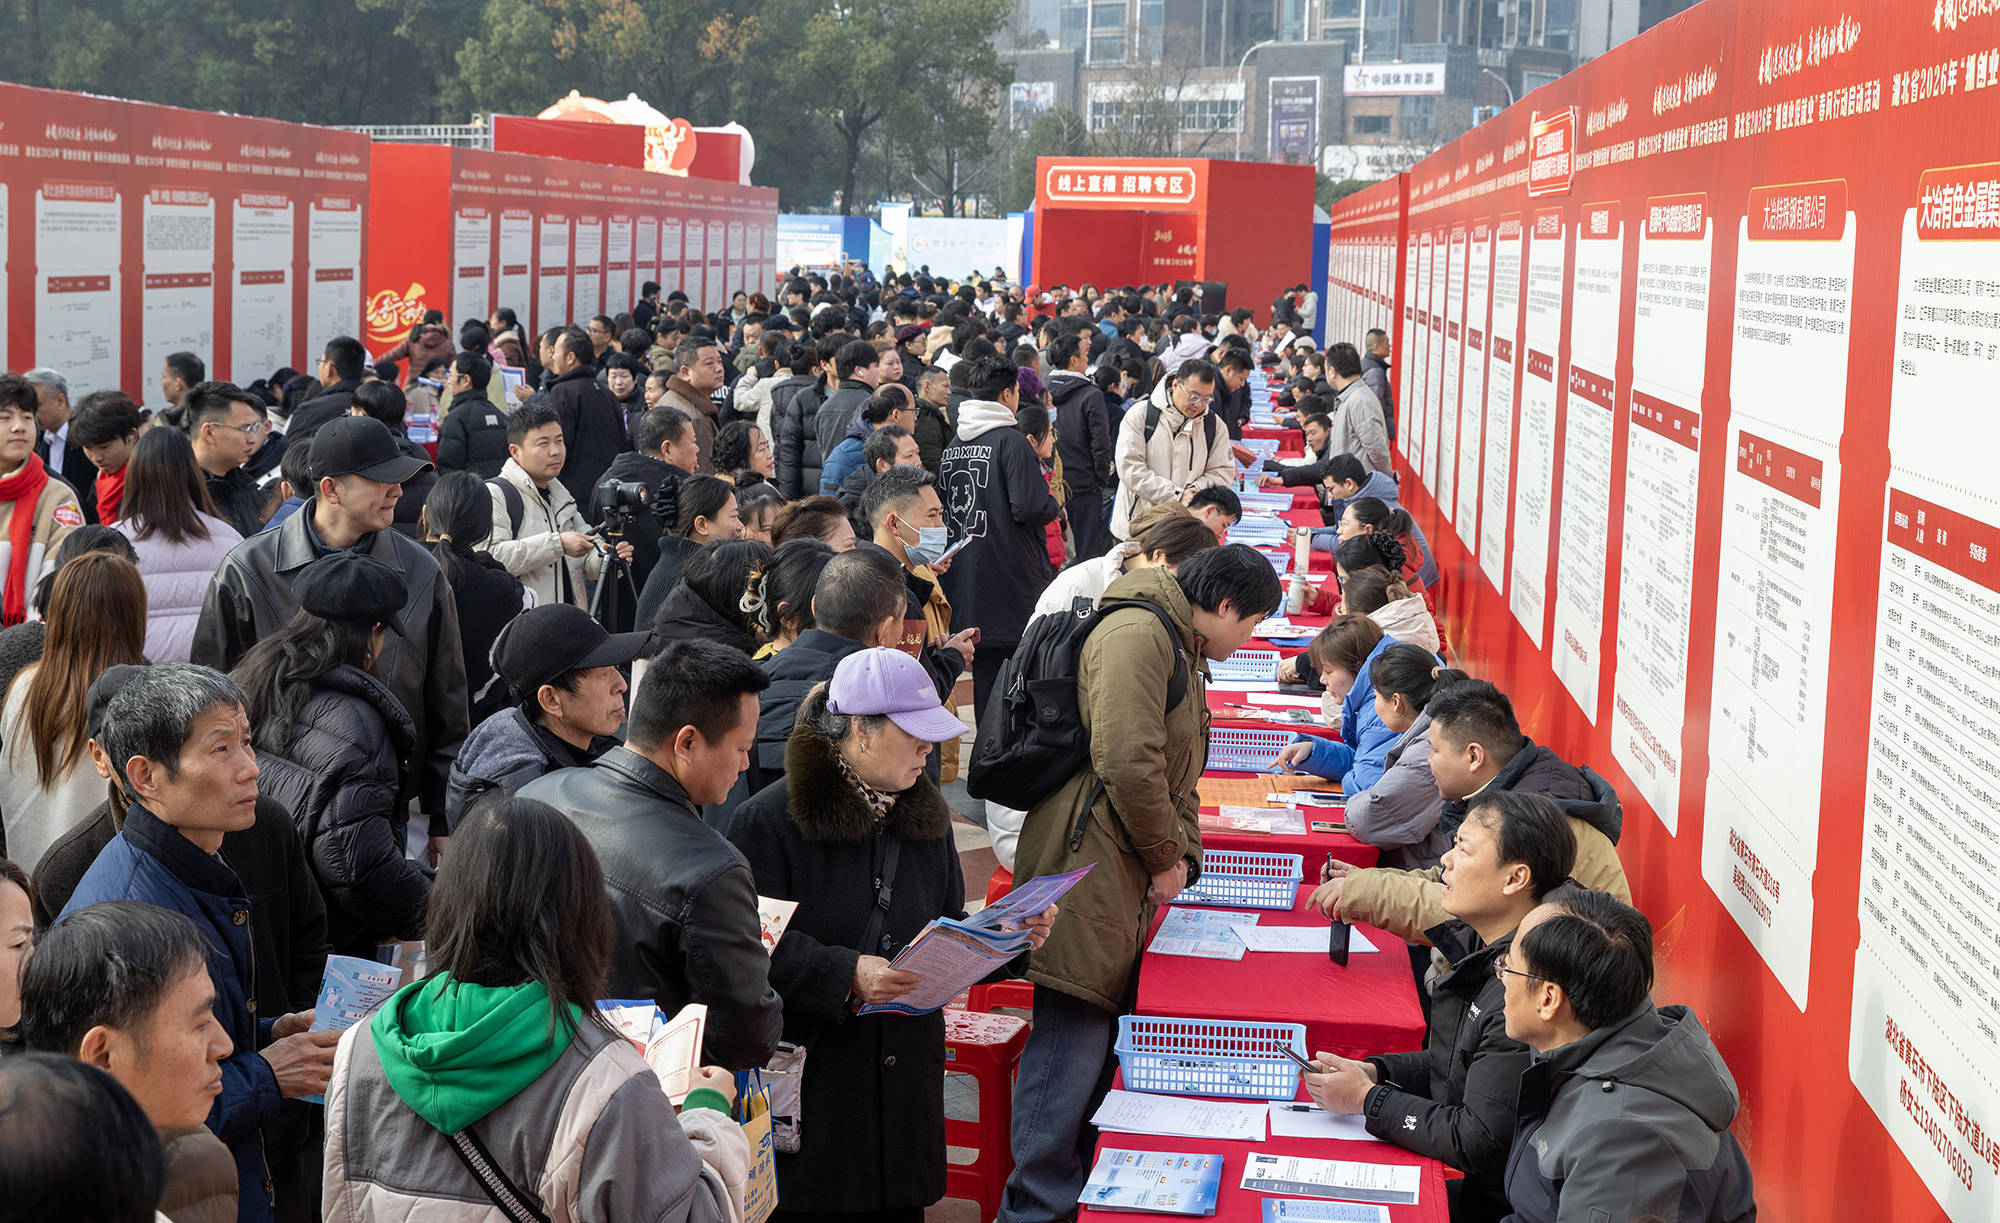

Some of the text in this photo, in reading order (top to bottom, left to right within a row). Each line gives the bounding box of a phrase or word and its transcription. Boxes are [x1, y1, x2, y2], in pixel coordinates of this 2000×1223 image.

[1371, 71, 1434, 86] 中国体育彩票
[1058, 175, 1184, 194] 线上直播 招聘专区
[1762, 195, 1827, 231] 大冶特殊钢有限公司
[1920, 179, 2000, 230] 大冶有色金属集
[941, 445, 993, 463] JIAXUN
[1884, 1013, 2000, 1177] 湖北省黄石市下陆区下陆大道18号
[1899, 1075, 1974, 1192] 杨女士13402706033
